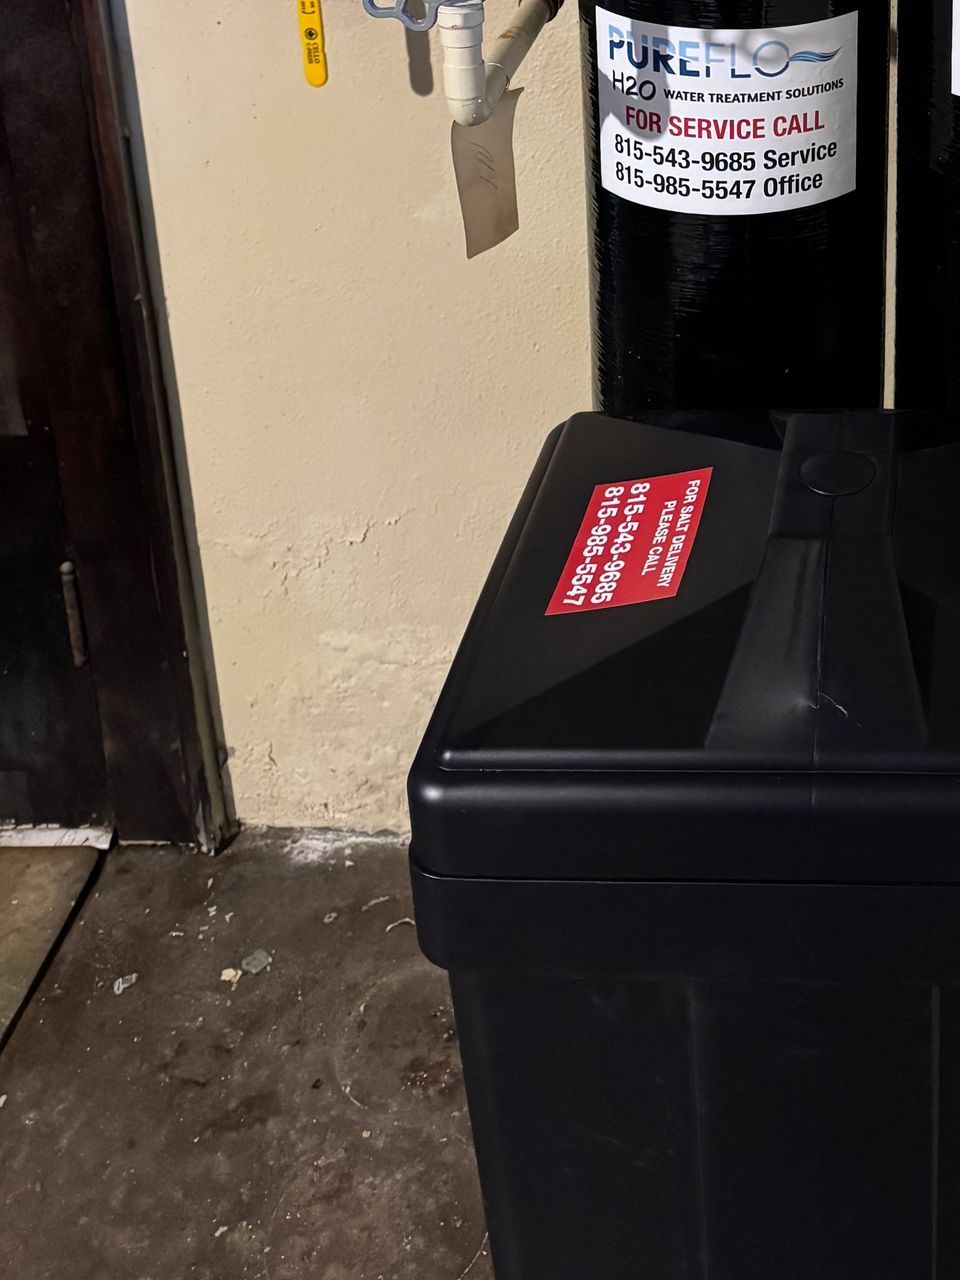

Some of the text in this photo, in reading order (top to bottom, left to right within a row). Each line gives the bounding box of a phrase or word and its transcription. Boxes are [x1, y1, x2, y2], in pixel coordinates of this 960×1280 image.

[608, 24, 789, 78] PUREFLO
[612, 70, 843, 103] H2O WATER TREATMENT SOLUTIONS
[625, 105, 825, 139] FOR SERVICE CALL
[615, 134, 837, 171] 815-543-9685 Service
[616, 162, 822, 199] 815-985-5547 Office
[562, 486, 624, 606] 815-985-5547
[590, 482, 651, 604] 815-543-9685
[641, 500, 677, 576] PLEASE CALL
[656, 479, 701, 587] FOR SALT DELIVERY
